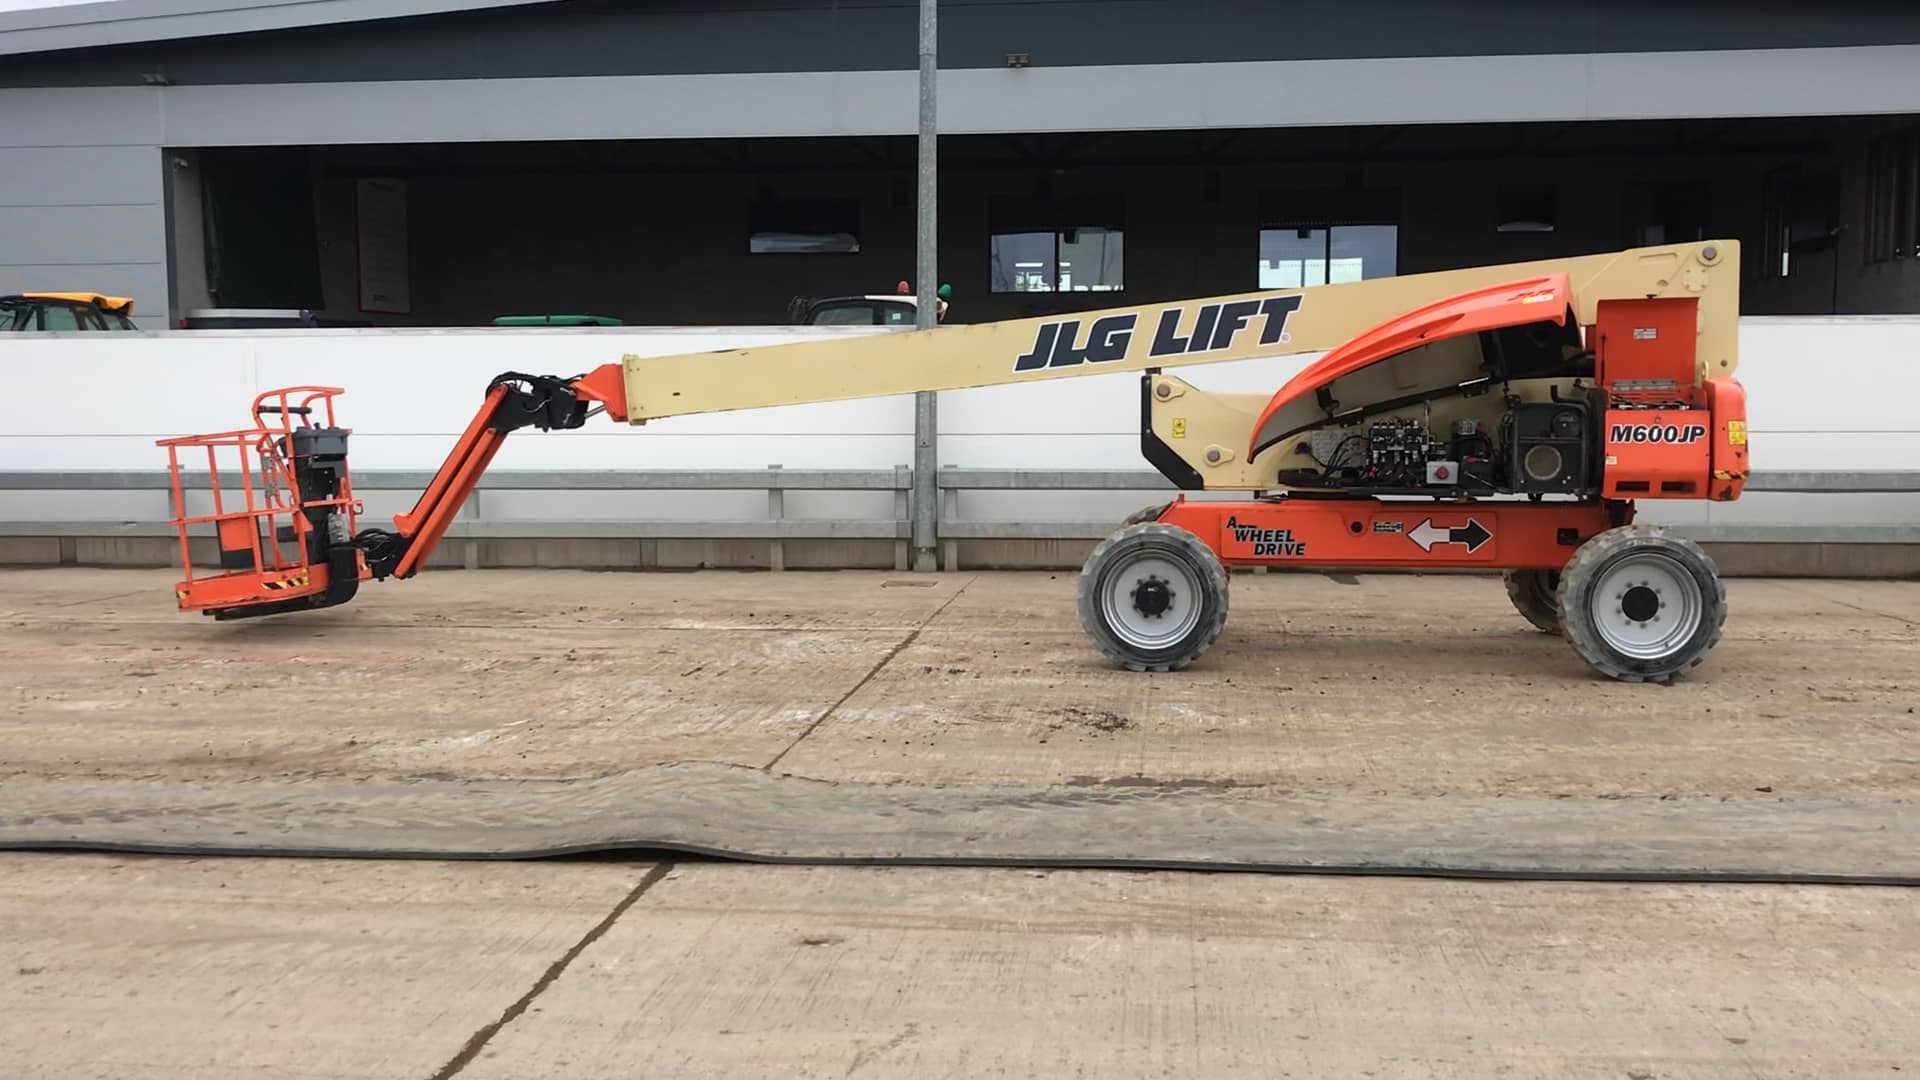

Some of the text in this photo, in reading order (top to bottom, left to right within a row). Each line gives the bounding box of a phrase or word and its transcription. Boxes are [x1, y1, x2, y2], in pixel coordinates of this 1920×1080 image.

[1015, 295, 1303, 371] JLG LIFT
[1610, 425, 1705, 443] M600JP
[1235, 529, 1296, 542] WHEEL
[1254, 543, 1306, 556] DRIVE
